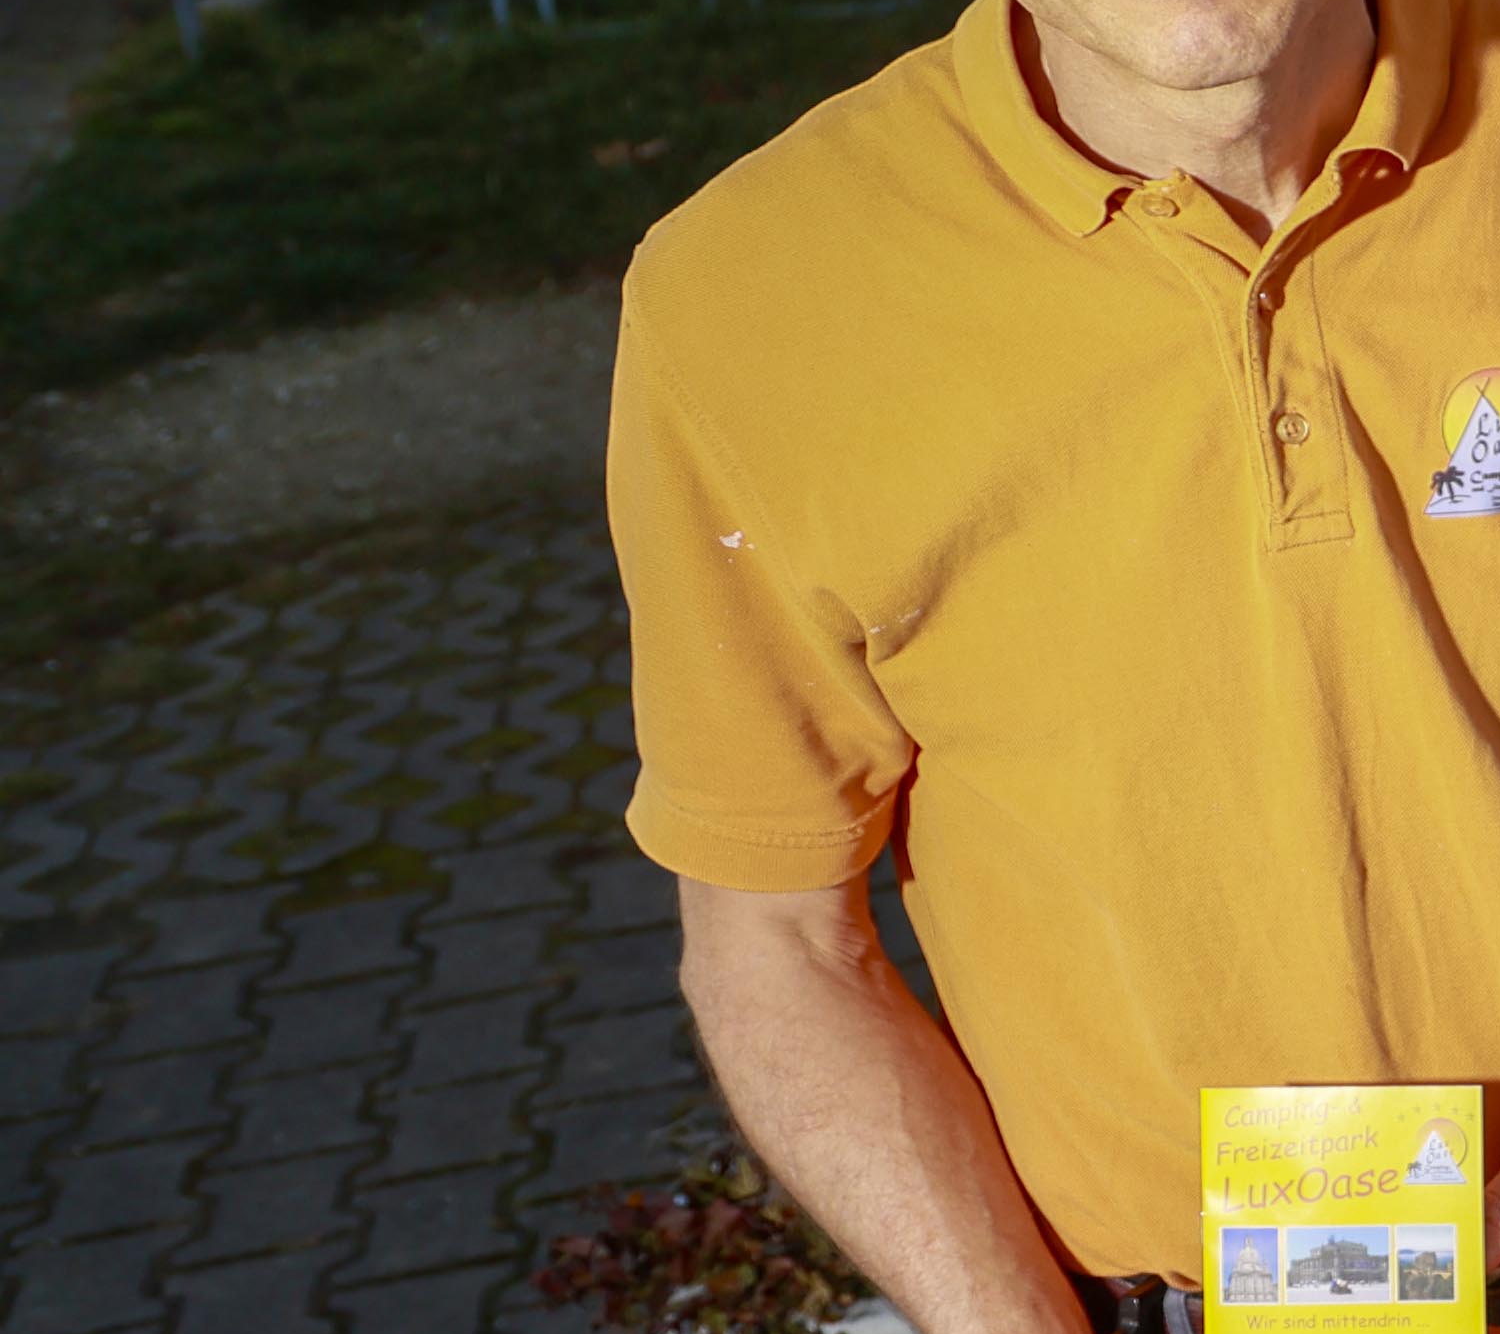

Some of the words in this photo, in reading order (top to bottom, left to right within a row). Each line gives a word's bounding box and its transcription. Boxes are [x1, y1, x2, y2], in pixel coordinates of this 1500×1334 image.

[1217, 1126, 1379, 1166] Freizeitpark
[1224, 1167, 1400, 1213] LuxOase
[1246, 1315, 1277, 1330] Wir
[1283, 1314, 1316, 1329] sind
[1322, 1313, 1411, 1328] mittendrin
